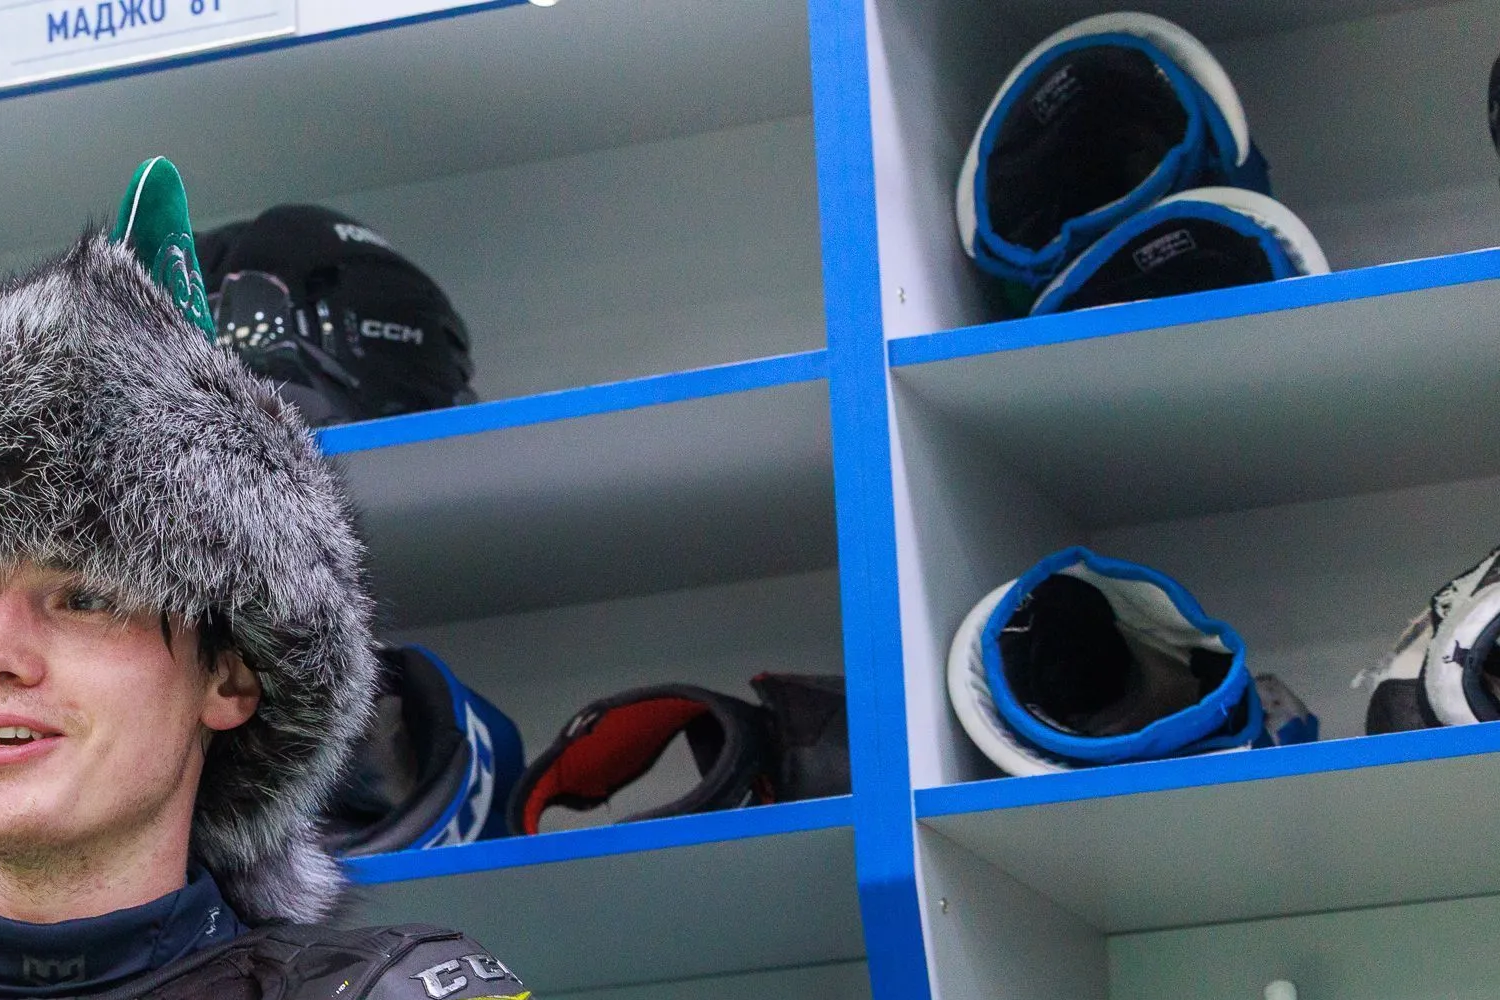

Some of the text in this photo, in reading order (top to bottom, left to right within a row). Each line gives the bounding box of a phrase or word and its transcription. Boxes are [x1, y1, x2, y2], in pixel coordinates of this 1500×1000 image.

[46, 0, 166, 43] МАДЖО
[361, 320, 423, 344] CCM
[409, 953, 524, 1000] CC
